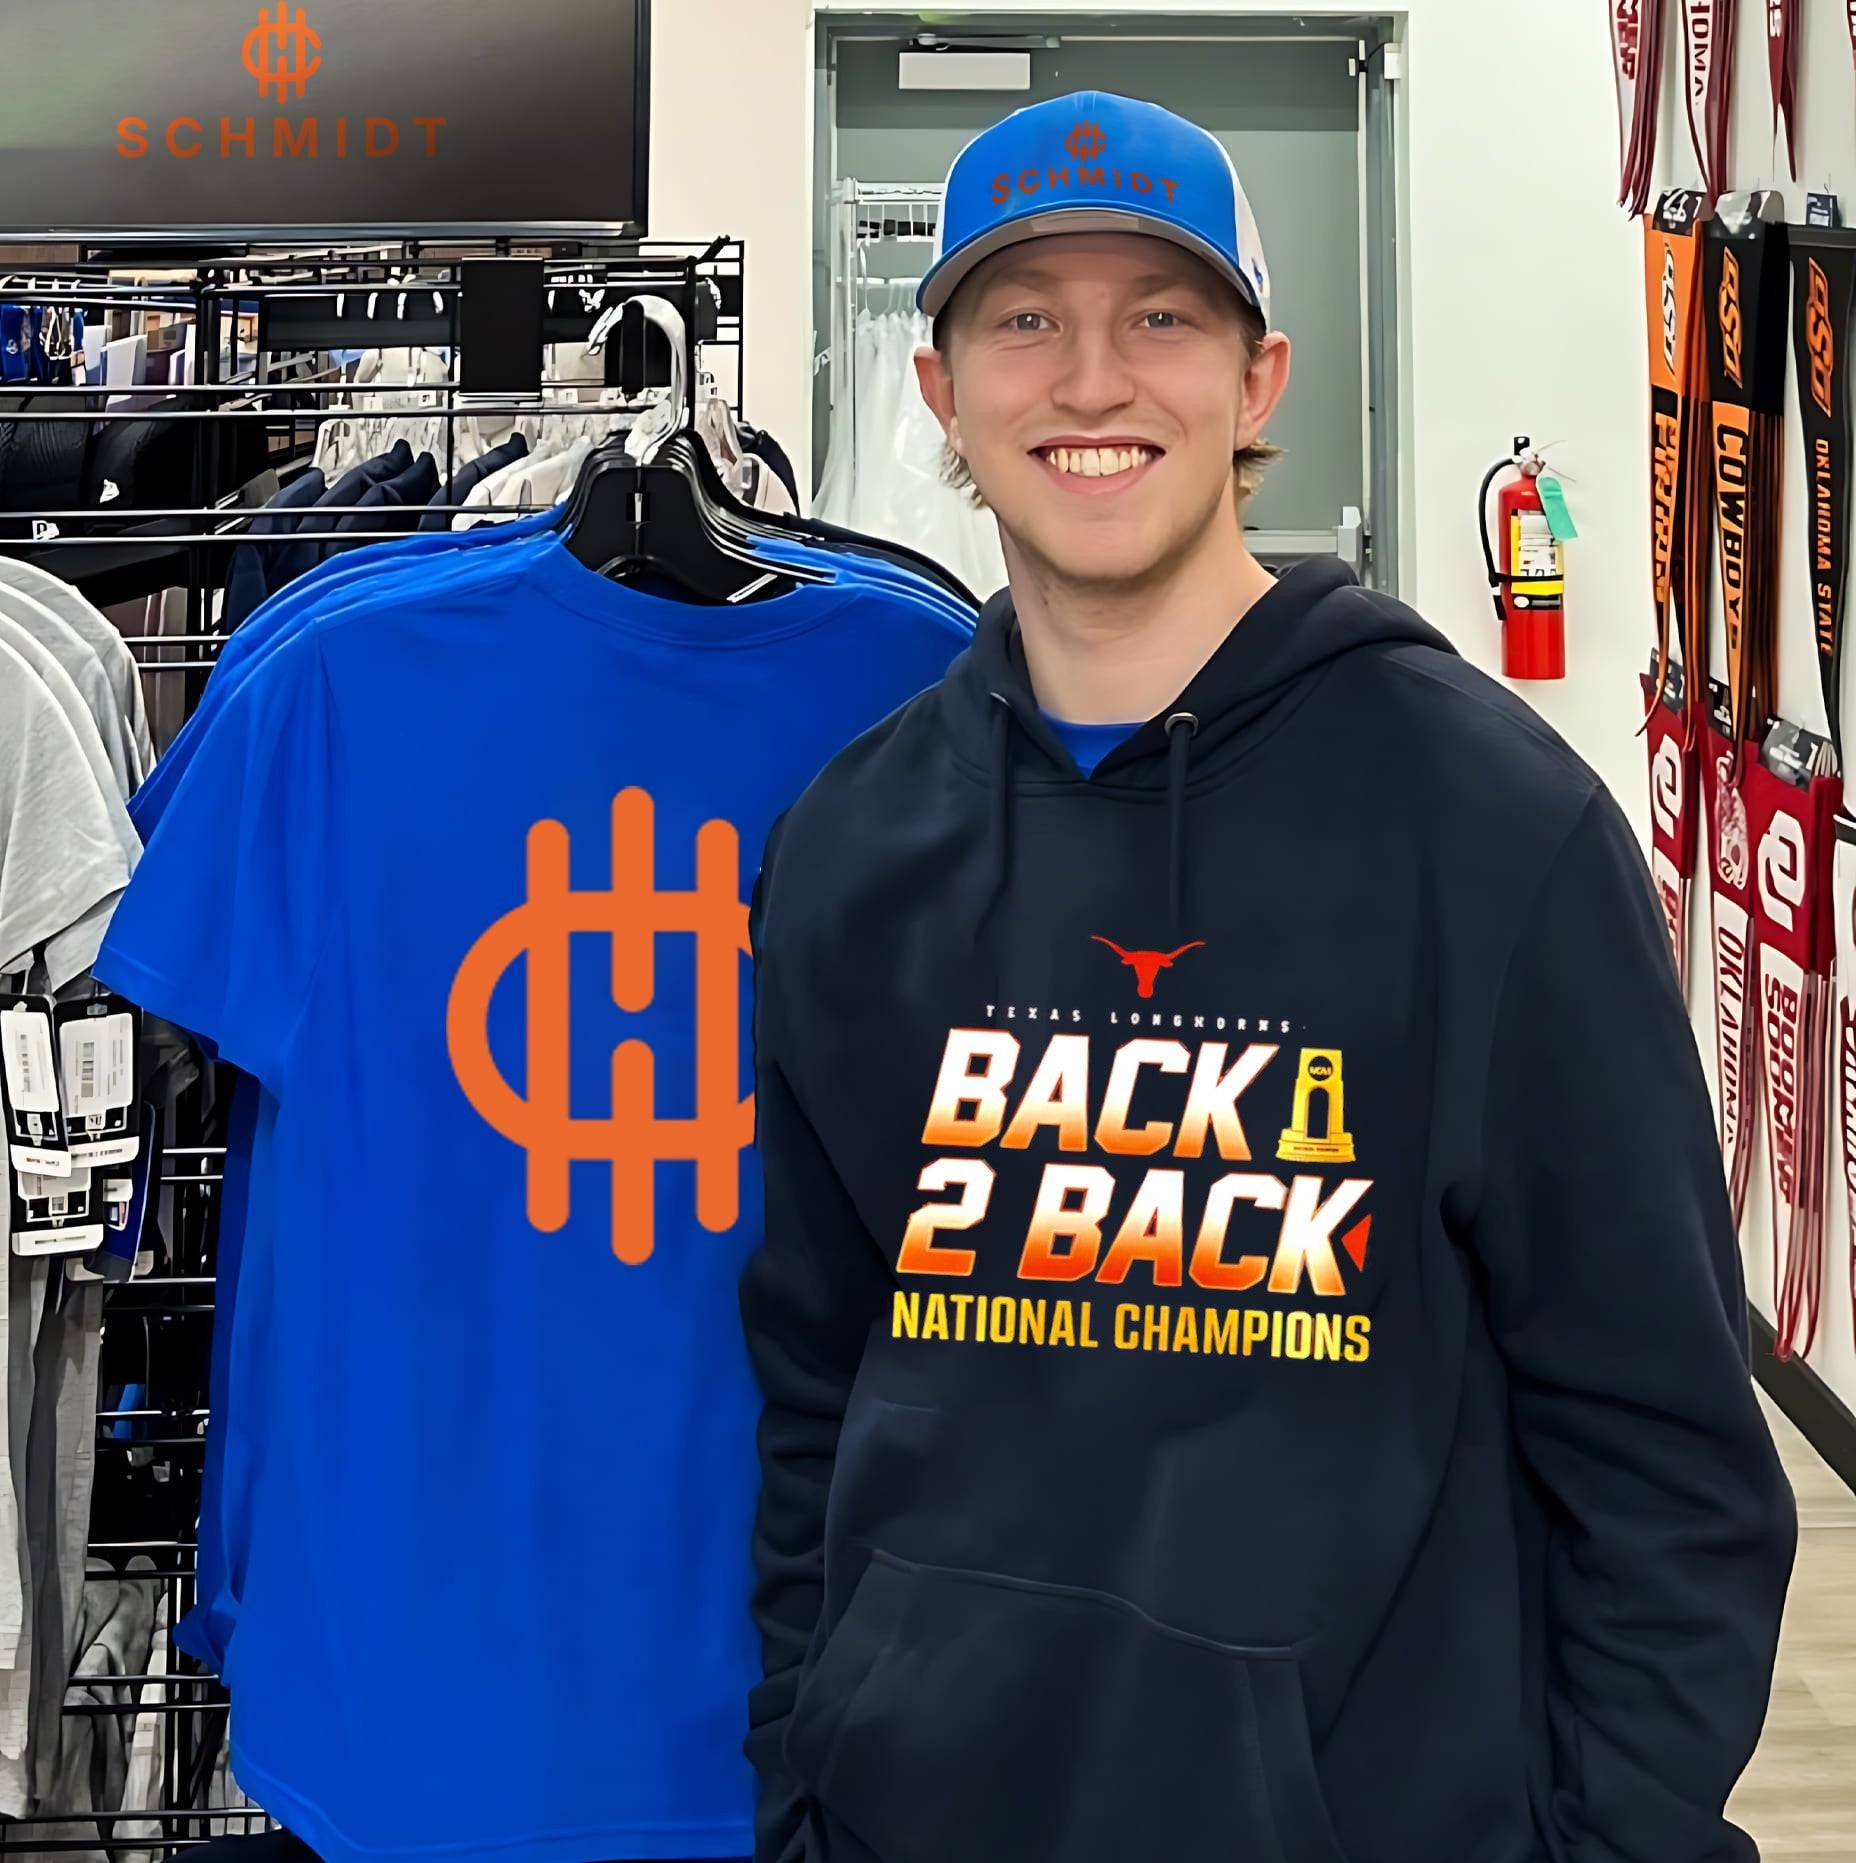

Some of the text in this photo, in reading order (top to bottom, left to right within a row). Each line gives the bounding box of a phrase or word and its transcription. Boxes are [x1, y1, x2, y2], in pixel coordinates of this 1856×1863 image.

[115, 116, 447, 159] SCHMIDT
[991, 166, 1179, 205] SCHMIDT
[1815, 438, 1832, 570] OKLAHOMA
[985, 1004, 1291, 1034] TEXAS LONGHORNS
[920, 1027, 1280, 1161] BACK
[896, 1157, 1374, 1296] 2 BACK
[891, 1290, 1372, 1362] NATIONAL CHAMPIONS
